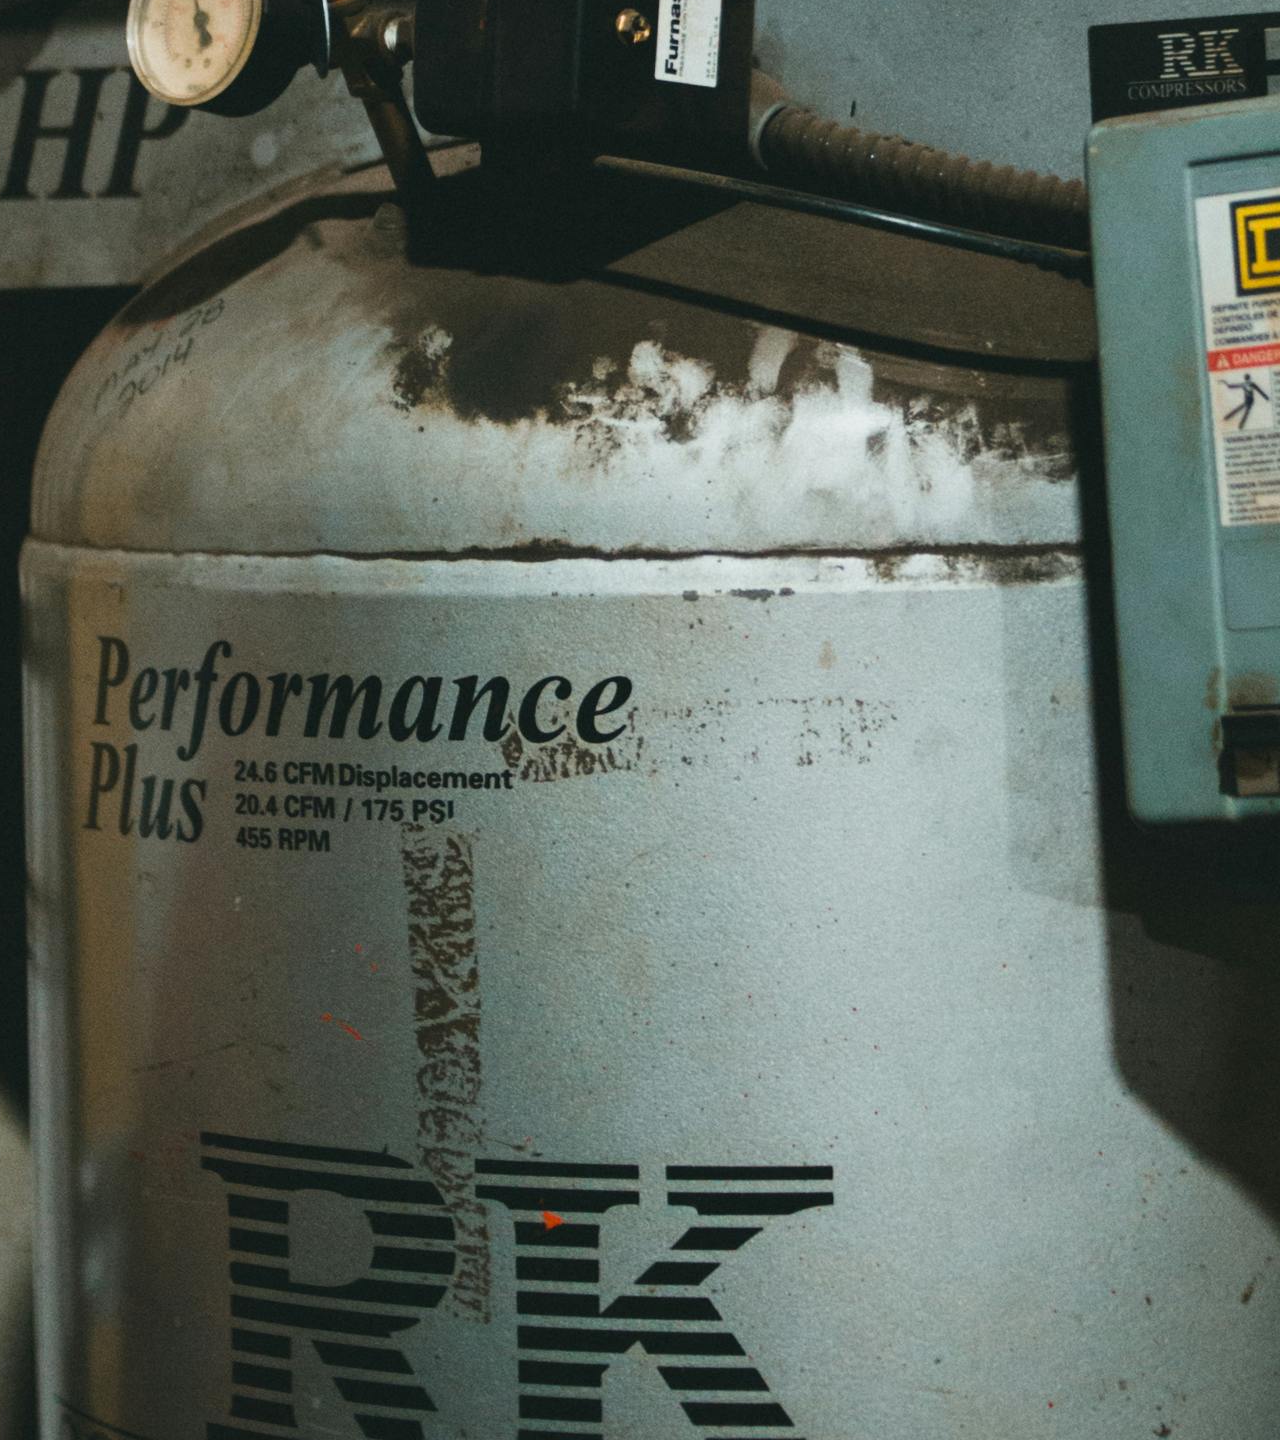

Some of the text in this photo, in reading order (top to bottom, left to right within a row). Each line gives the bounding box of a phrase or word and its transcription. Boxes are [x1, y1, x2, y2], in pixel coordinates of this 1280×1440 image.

[1157, 28, 1245, 79] RK
[1127, 77, 1248, 102] COMPRESSORS
[94, 635, 634, 761] Performance
[82, 740, 208, 843] Plus
[234, 760, 514, 794] 24.6 CFM Displacement
[234, 793, 455, 823] 20.4 CFM / 175 PSI
[235, 827, 332, 853] 455 RPM
